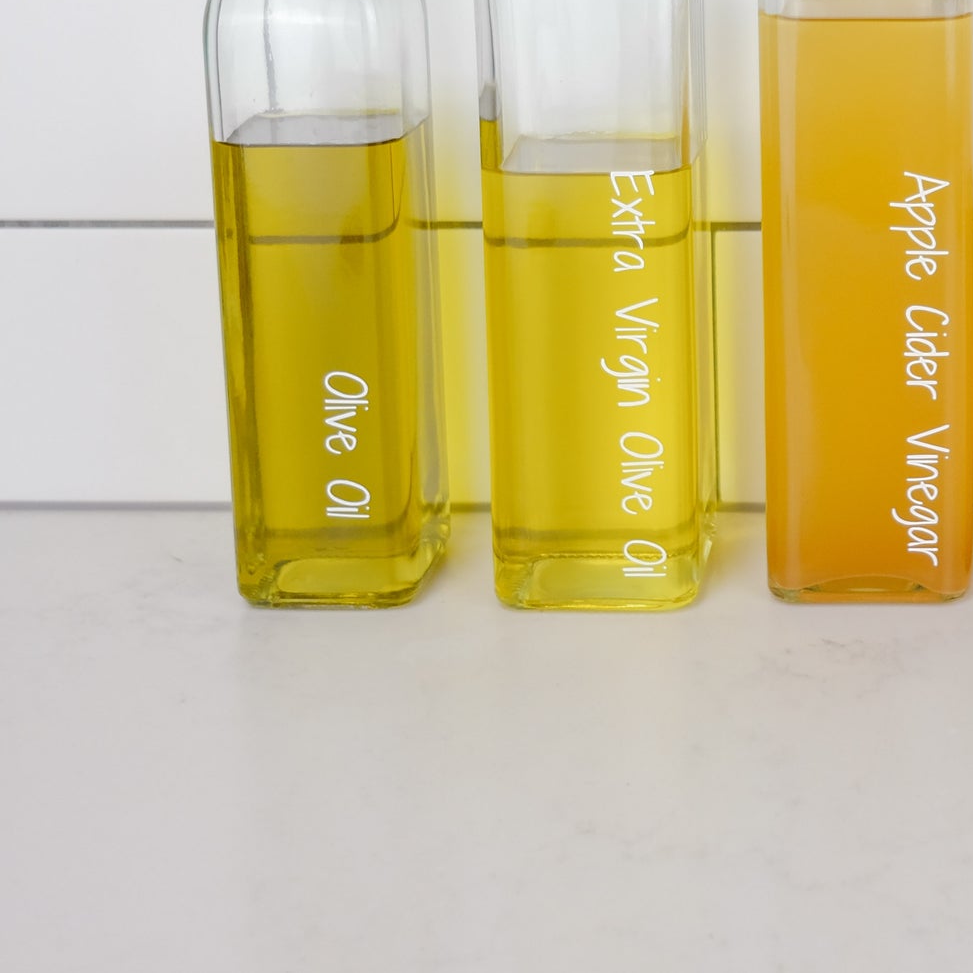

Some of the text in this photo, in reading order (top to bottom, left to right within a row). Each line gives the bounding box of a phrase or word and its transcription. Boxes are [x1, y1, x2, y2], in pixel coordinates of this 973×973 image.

[323, 371, 371, 520] Olive Oil
[601, 169, 667, 578] Extra Virgin Olive Oil
[889, 171, 951, 567] Apple Cider Vinegar
